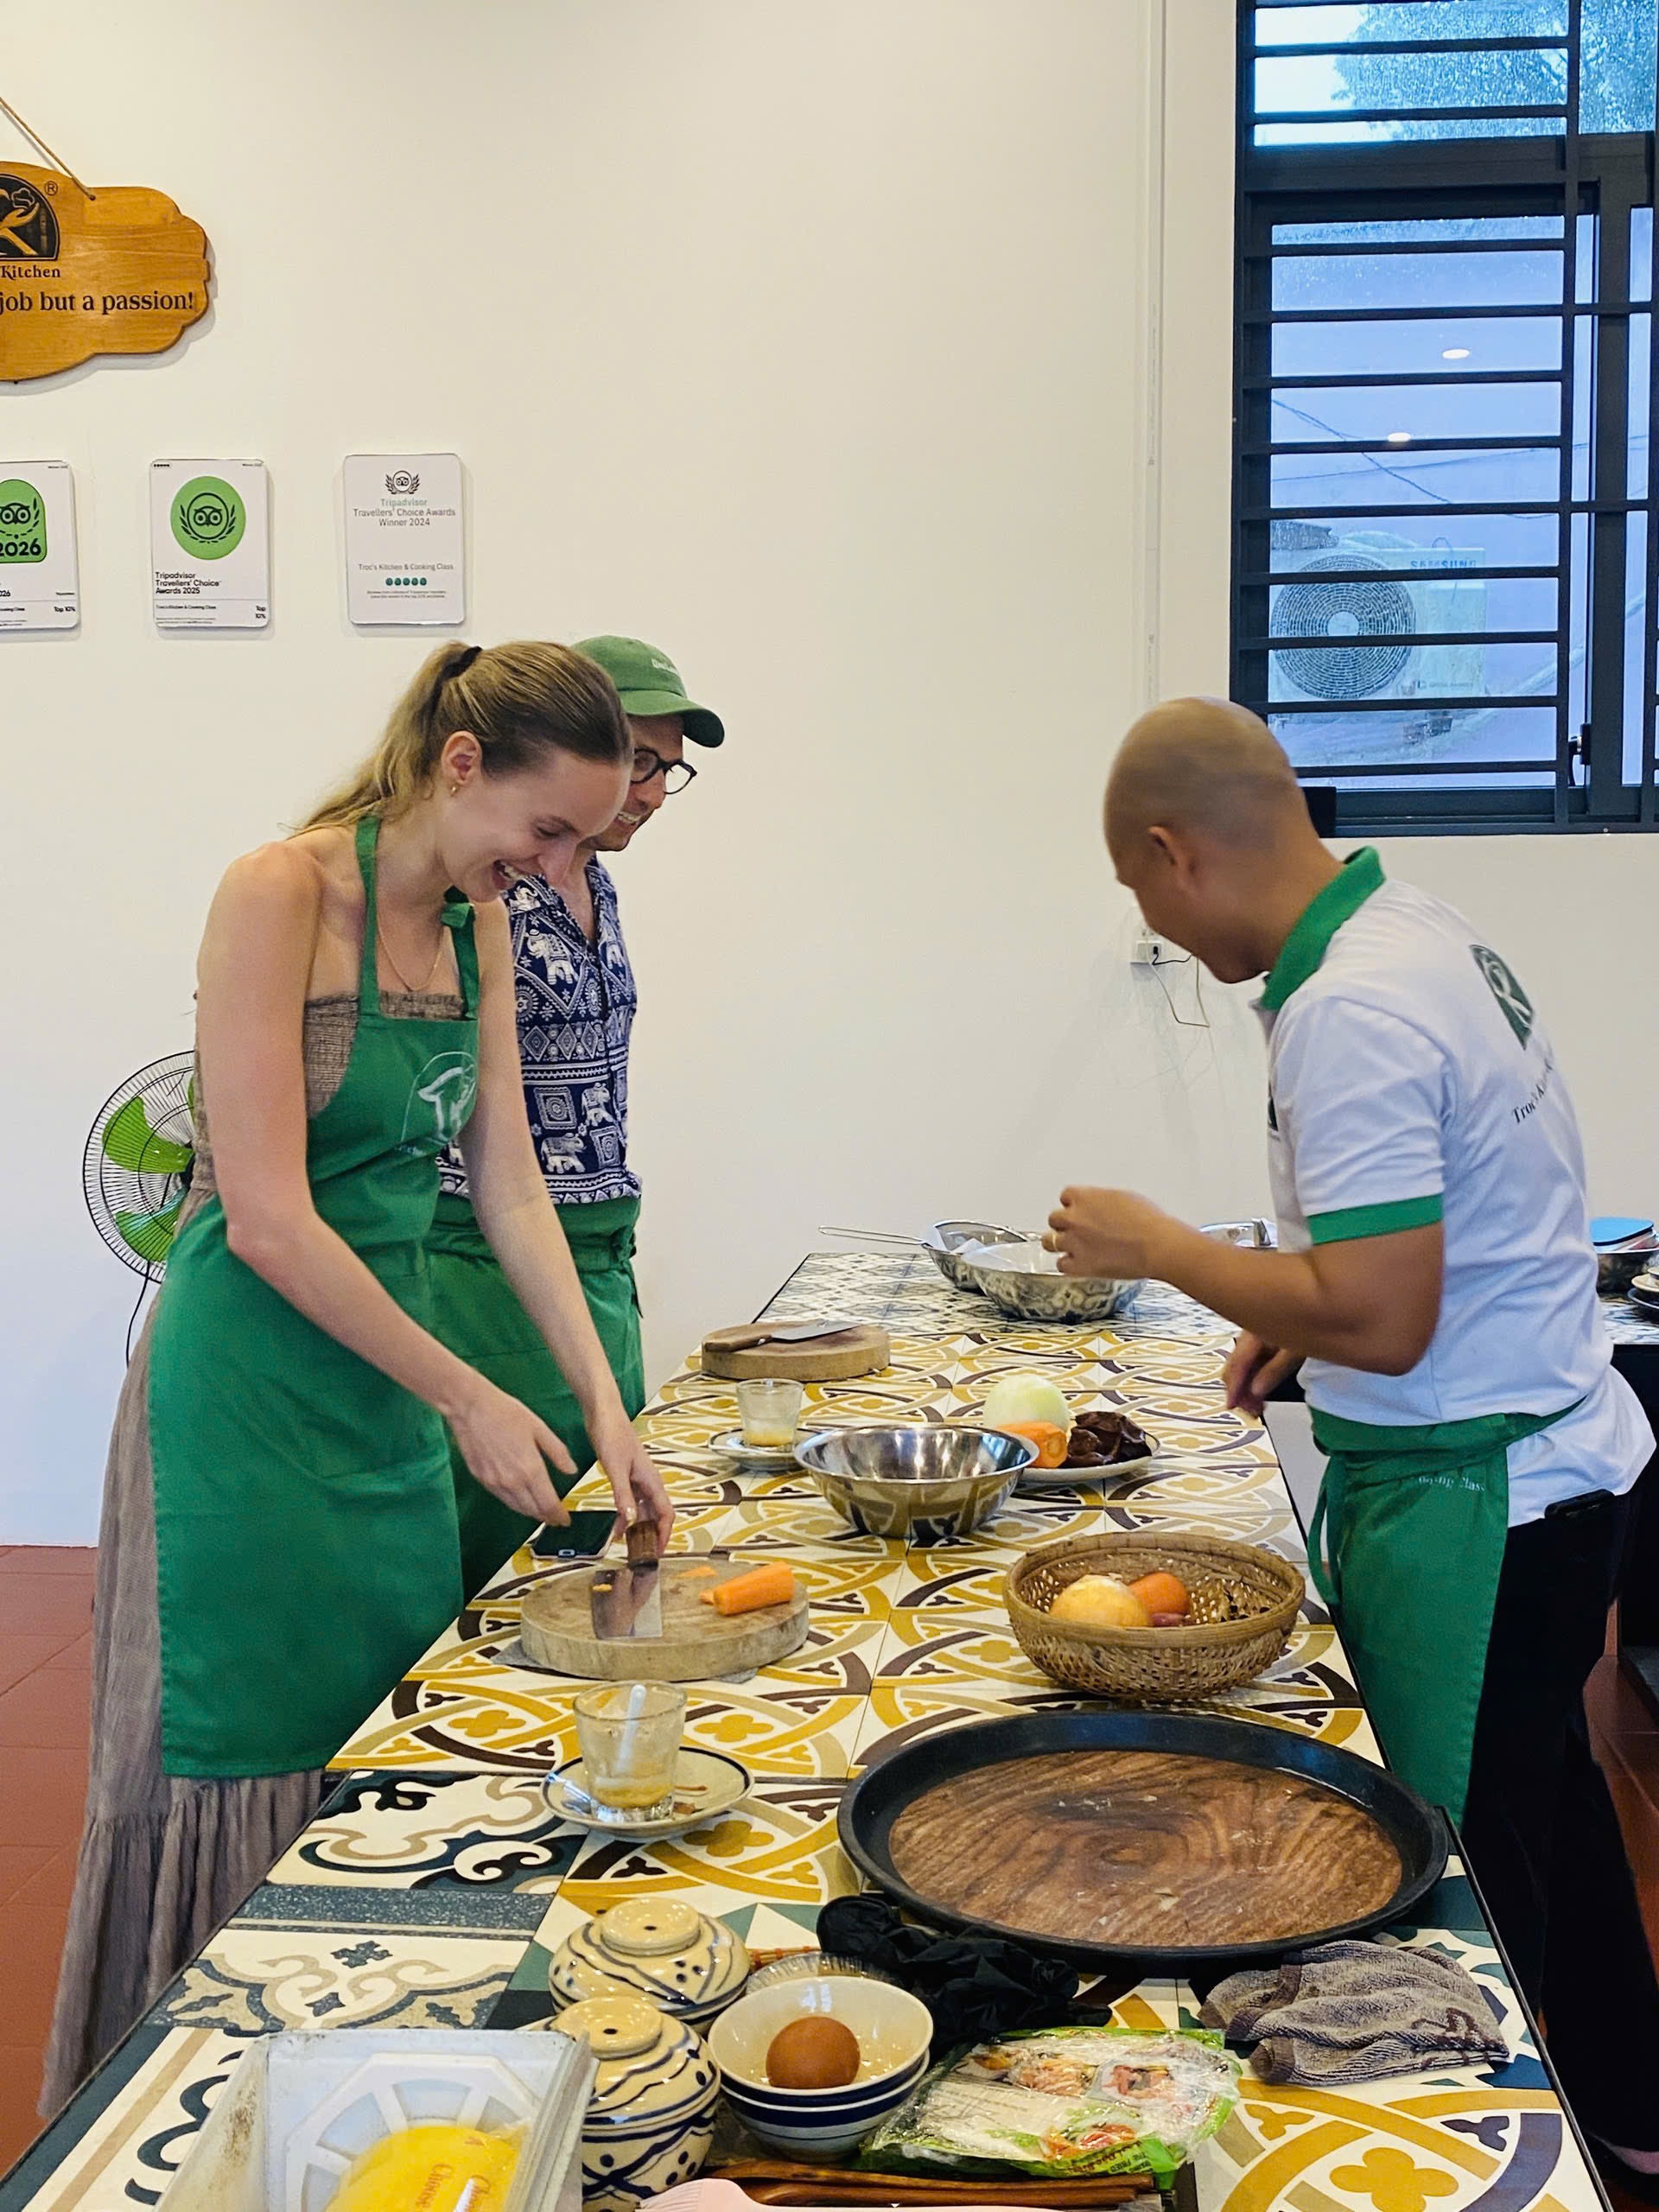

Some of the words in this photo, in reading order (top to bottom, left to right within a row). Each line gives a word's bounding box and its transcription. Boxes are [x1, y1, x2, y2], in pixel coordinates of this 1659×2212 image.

[2, 264, 60, 280] Kitchen
[0, 291, 33, 315] job
[40, 291, 75, 311] but
[83, 295, 95, 310] a
[102, 290, 194, 315] passion!
[380, 498, 428, 507] Tripadvisor
[397, 508, 423, 517] Choice
[426, 508, 455, 517] Awards
[409, 518, 430, 526] 2024
